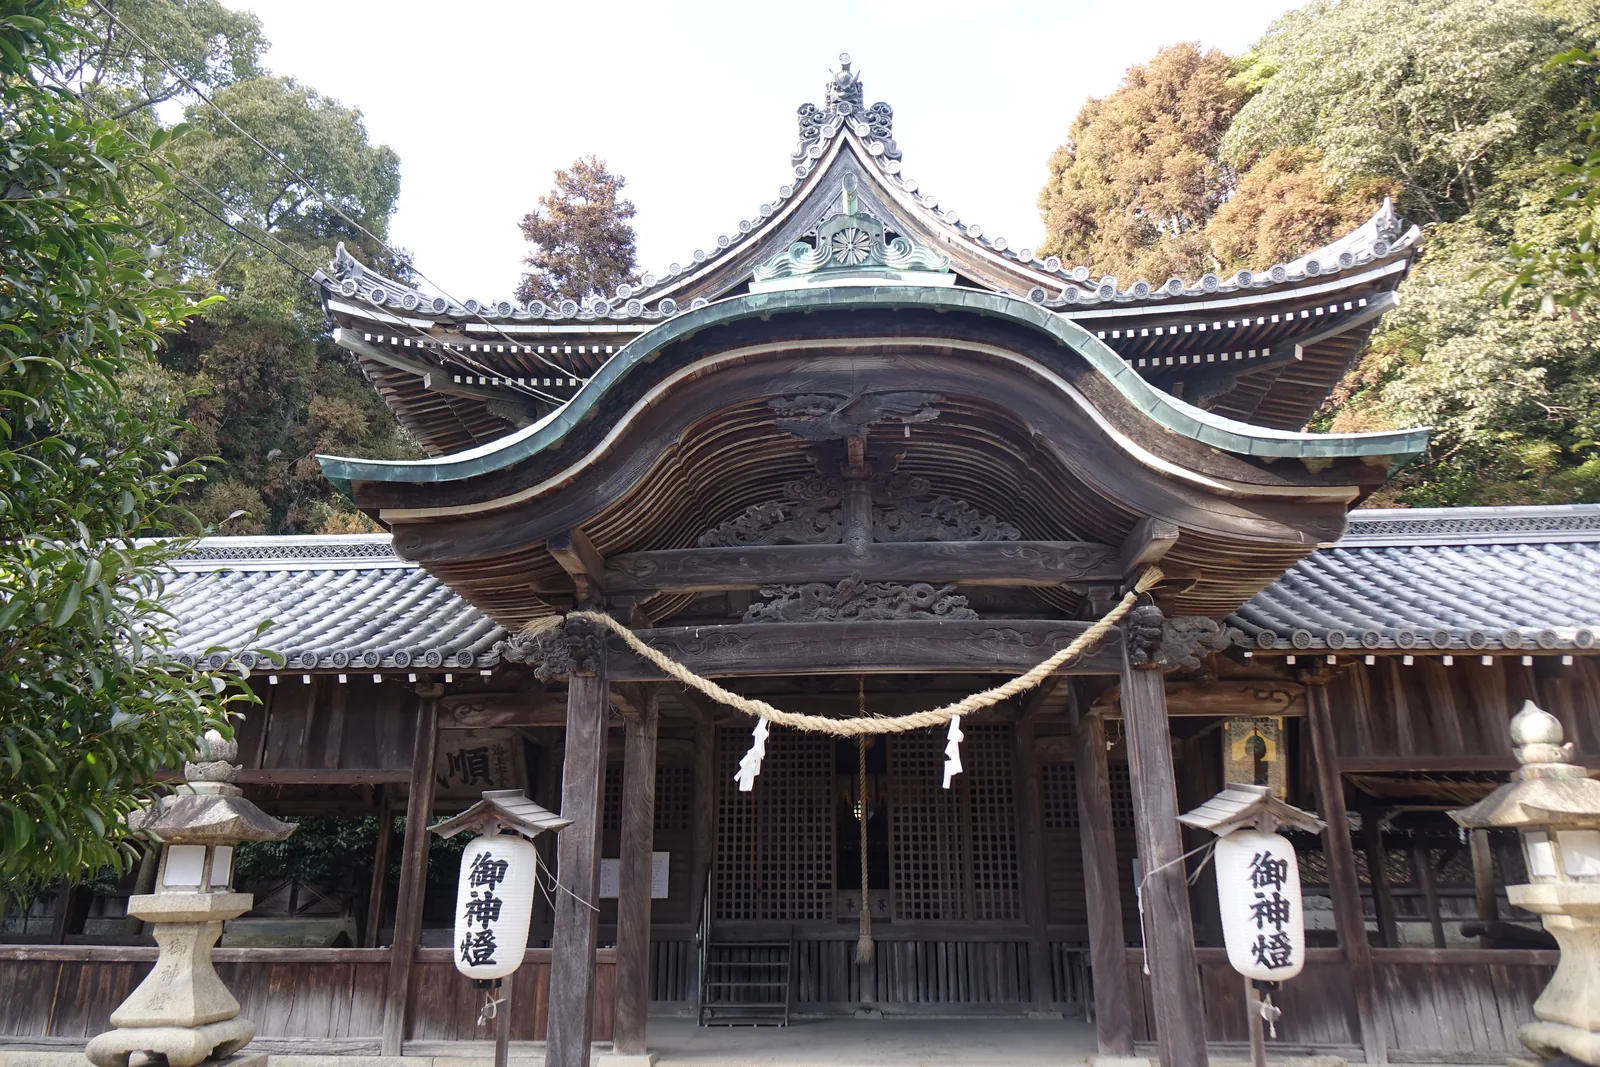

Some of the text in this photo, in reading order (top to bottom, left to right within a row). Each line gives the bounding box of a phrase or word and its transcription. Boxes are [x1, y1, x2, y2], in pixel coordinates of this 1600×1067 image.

[437, 746, 494, 789] 順
[460, 851, 509, 967] 御神燈
[1248, 850, 1293, 969] 御神燈
